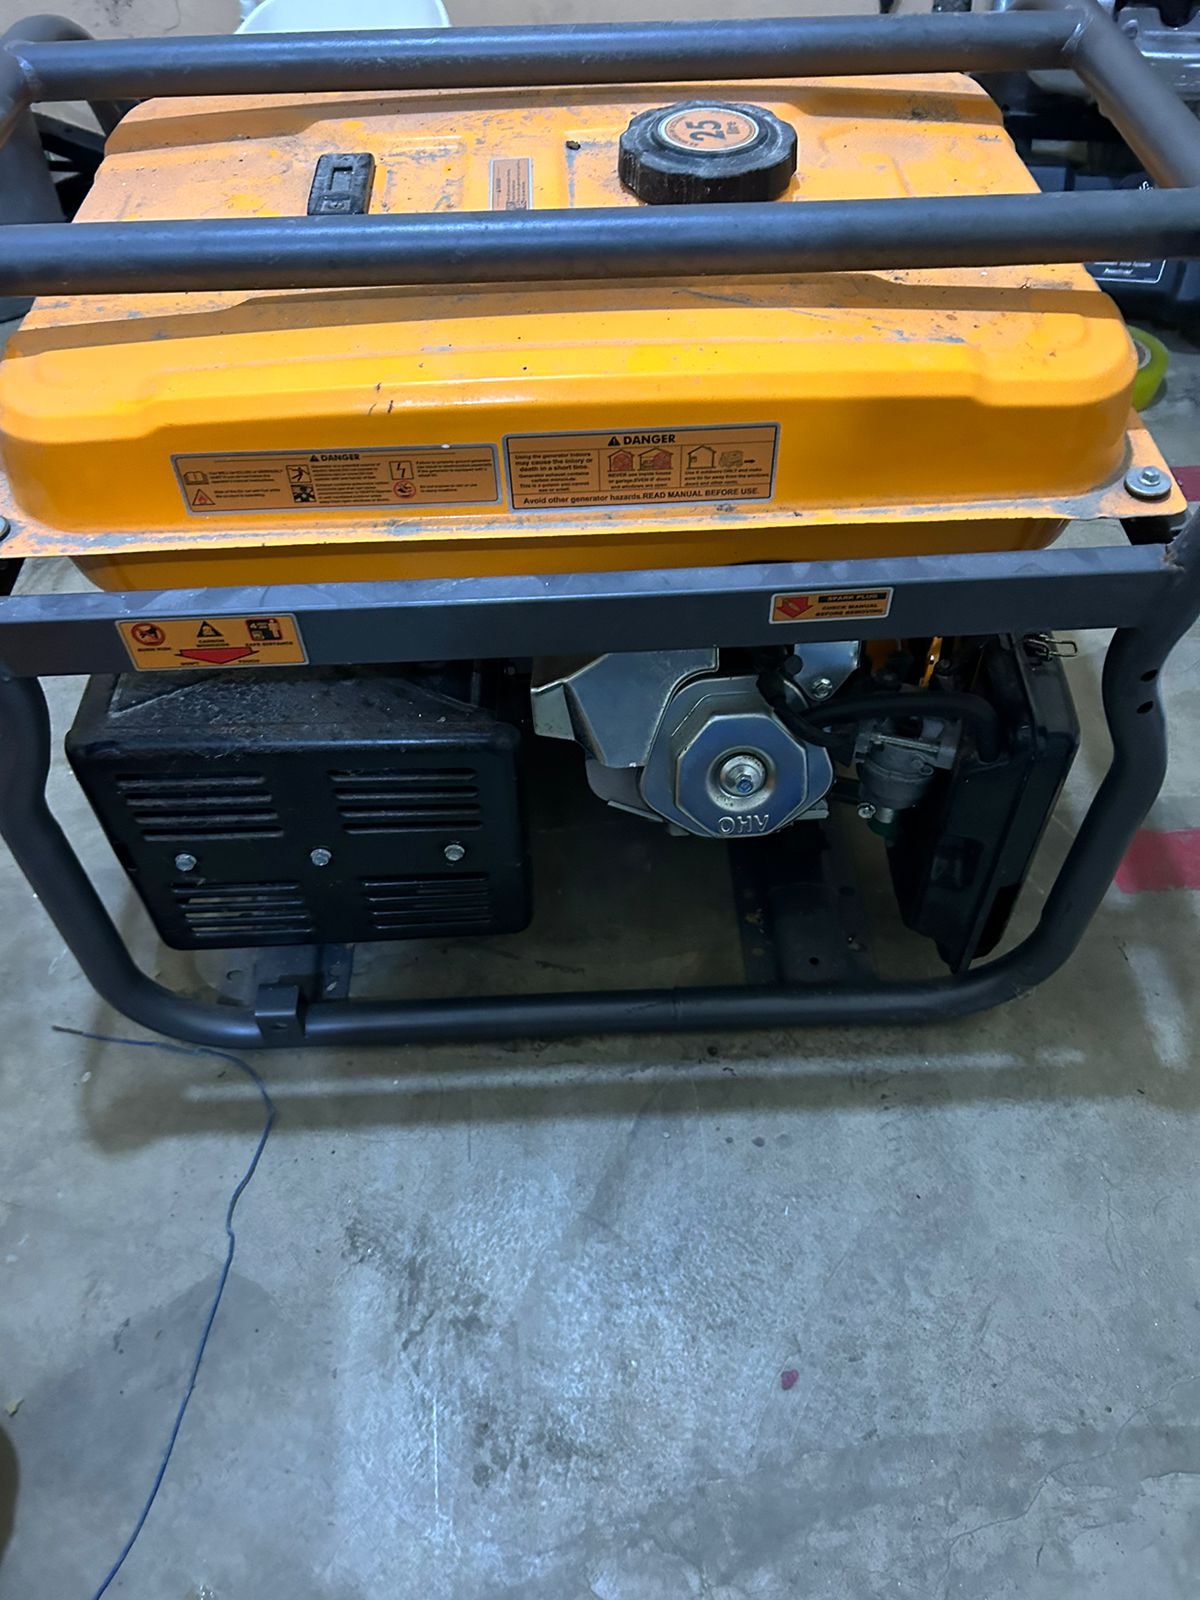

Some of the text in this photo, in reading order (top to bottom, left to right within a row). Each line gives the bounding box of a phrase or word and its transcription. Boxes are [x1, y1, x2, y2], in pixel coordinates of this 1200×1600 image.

[685, 120, 727, 142] 25
[623, 433, 676, 445] DANGER
[320, 453, 360, 462] DANGER
[523, 495, 546, 504] Avoid
[570, 494, 609, 504] generator
[642, 491, 666, 499] READ
[667, 490, 703, 498] MANUAL
[704, 488, 738, 497] BEFORE
[718, 814, 769, 834] OHV
